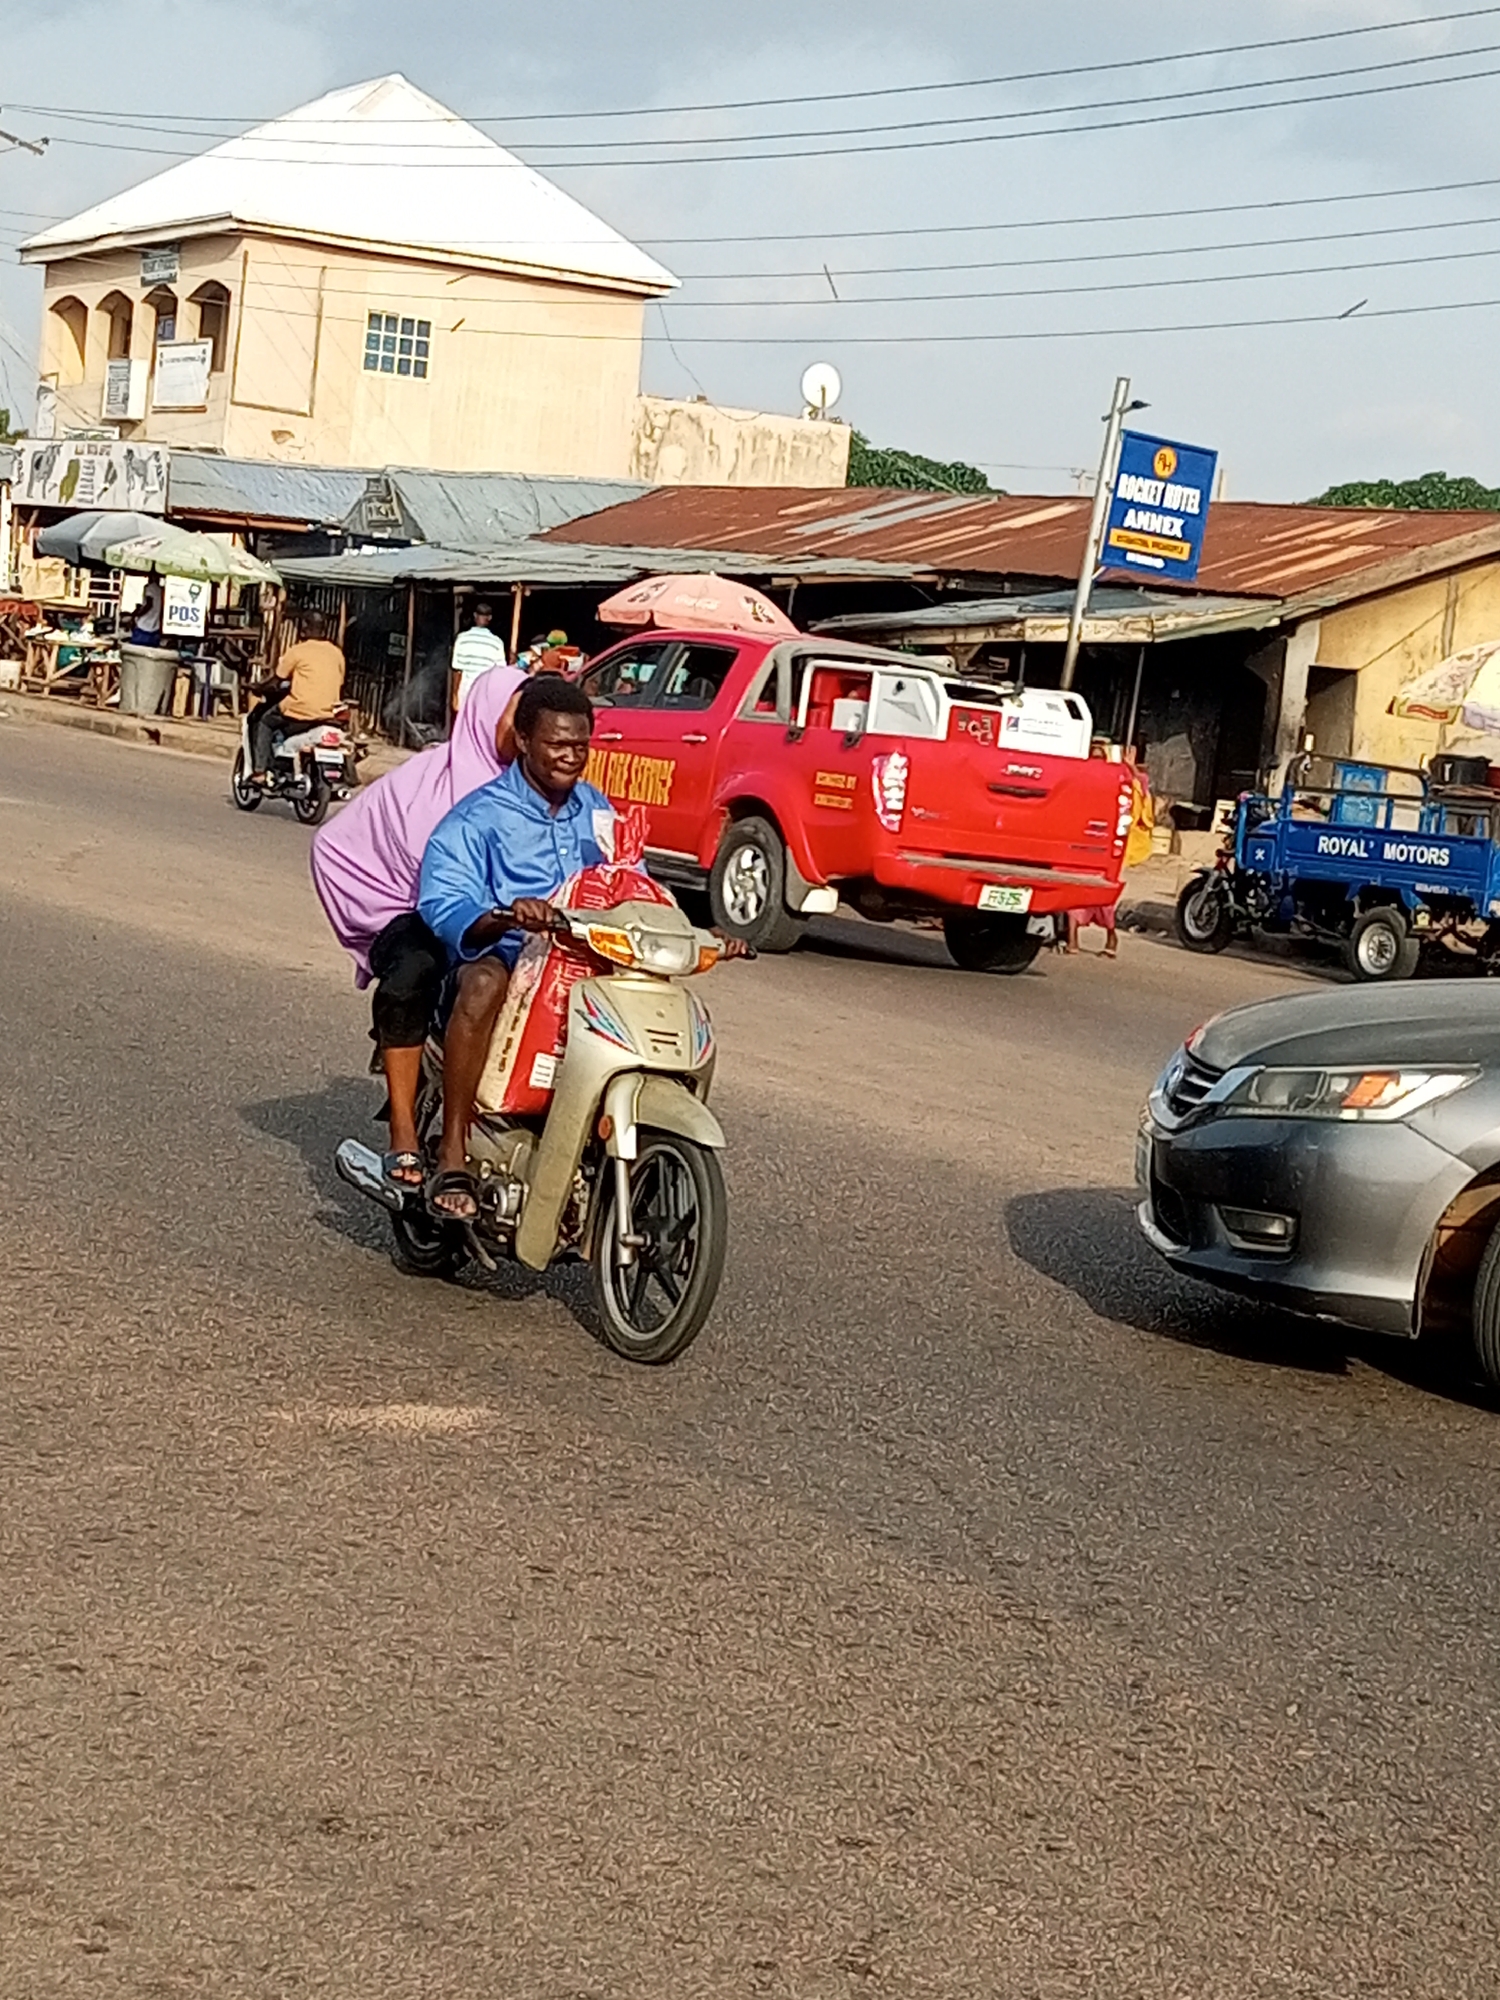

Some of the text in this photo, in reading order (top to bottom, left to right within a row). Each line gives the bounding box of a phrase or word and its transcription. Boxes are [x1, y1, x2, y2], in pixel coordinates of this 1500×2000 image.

[1116, 473, 1201, 515] ROCKET HOTEL
[1123, 508, 1186, 539] ANNEX
[169, 605, 200, 622] POS
[1383, 842, 1450, 866] MOTORS
